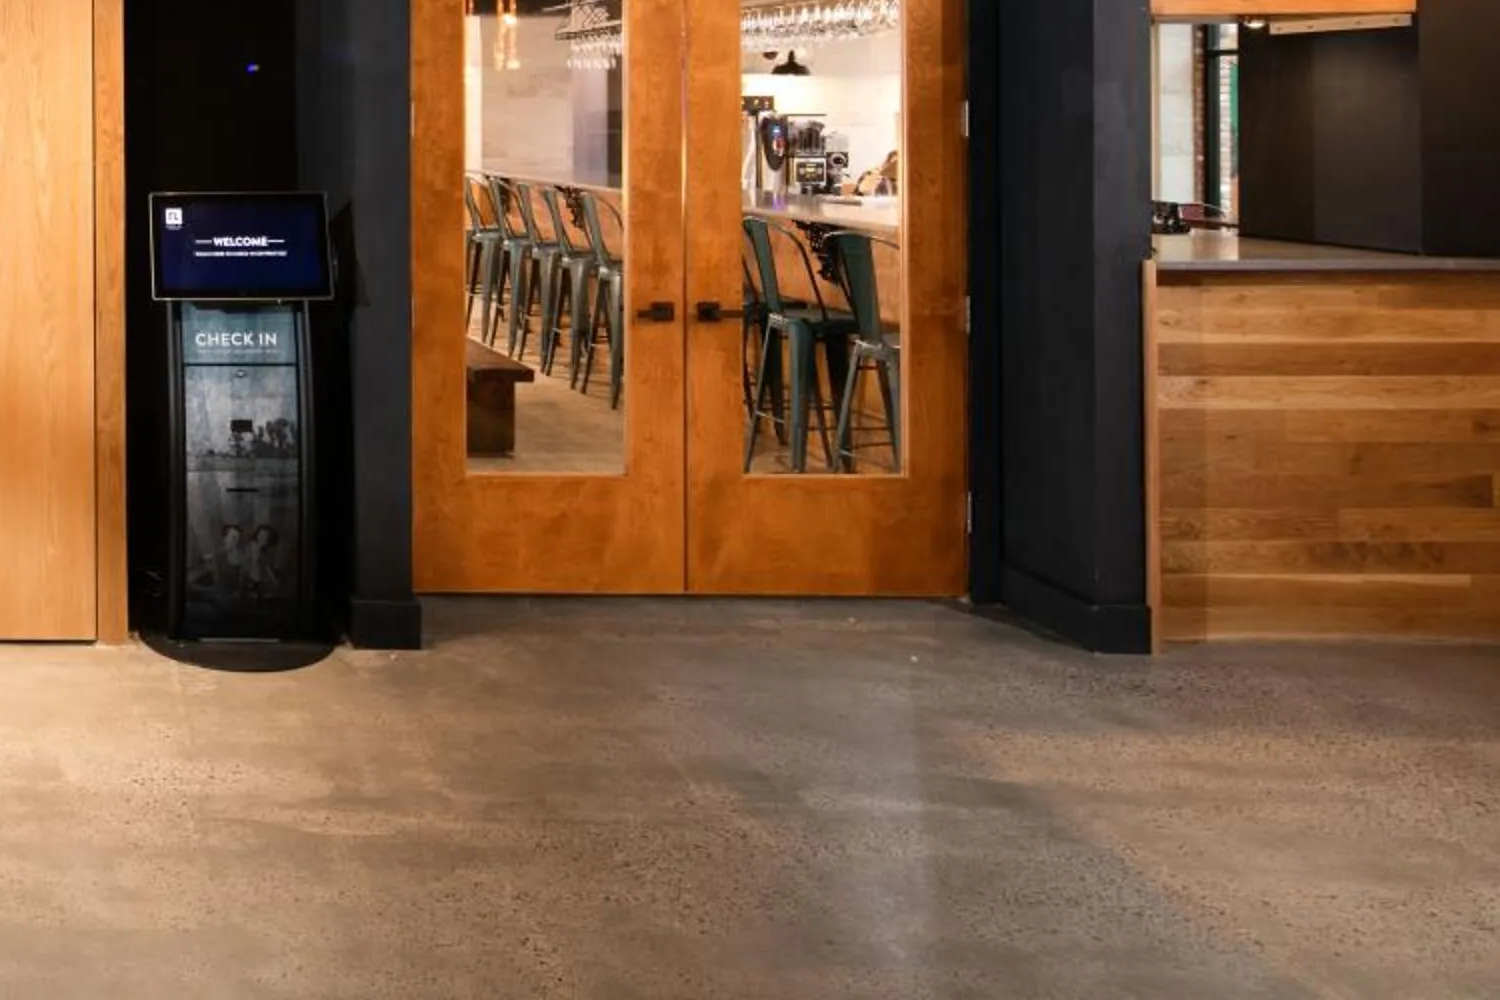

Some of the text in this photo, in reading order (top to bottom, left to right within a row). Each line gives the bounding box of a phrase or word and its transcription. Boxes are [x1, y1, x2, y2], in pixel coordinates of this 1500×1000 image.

[212, 235, 268, 247] WELCOME
[195, 331, 278, 347] CHECK IN
